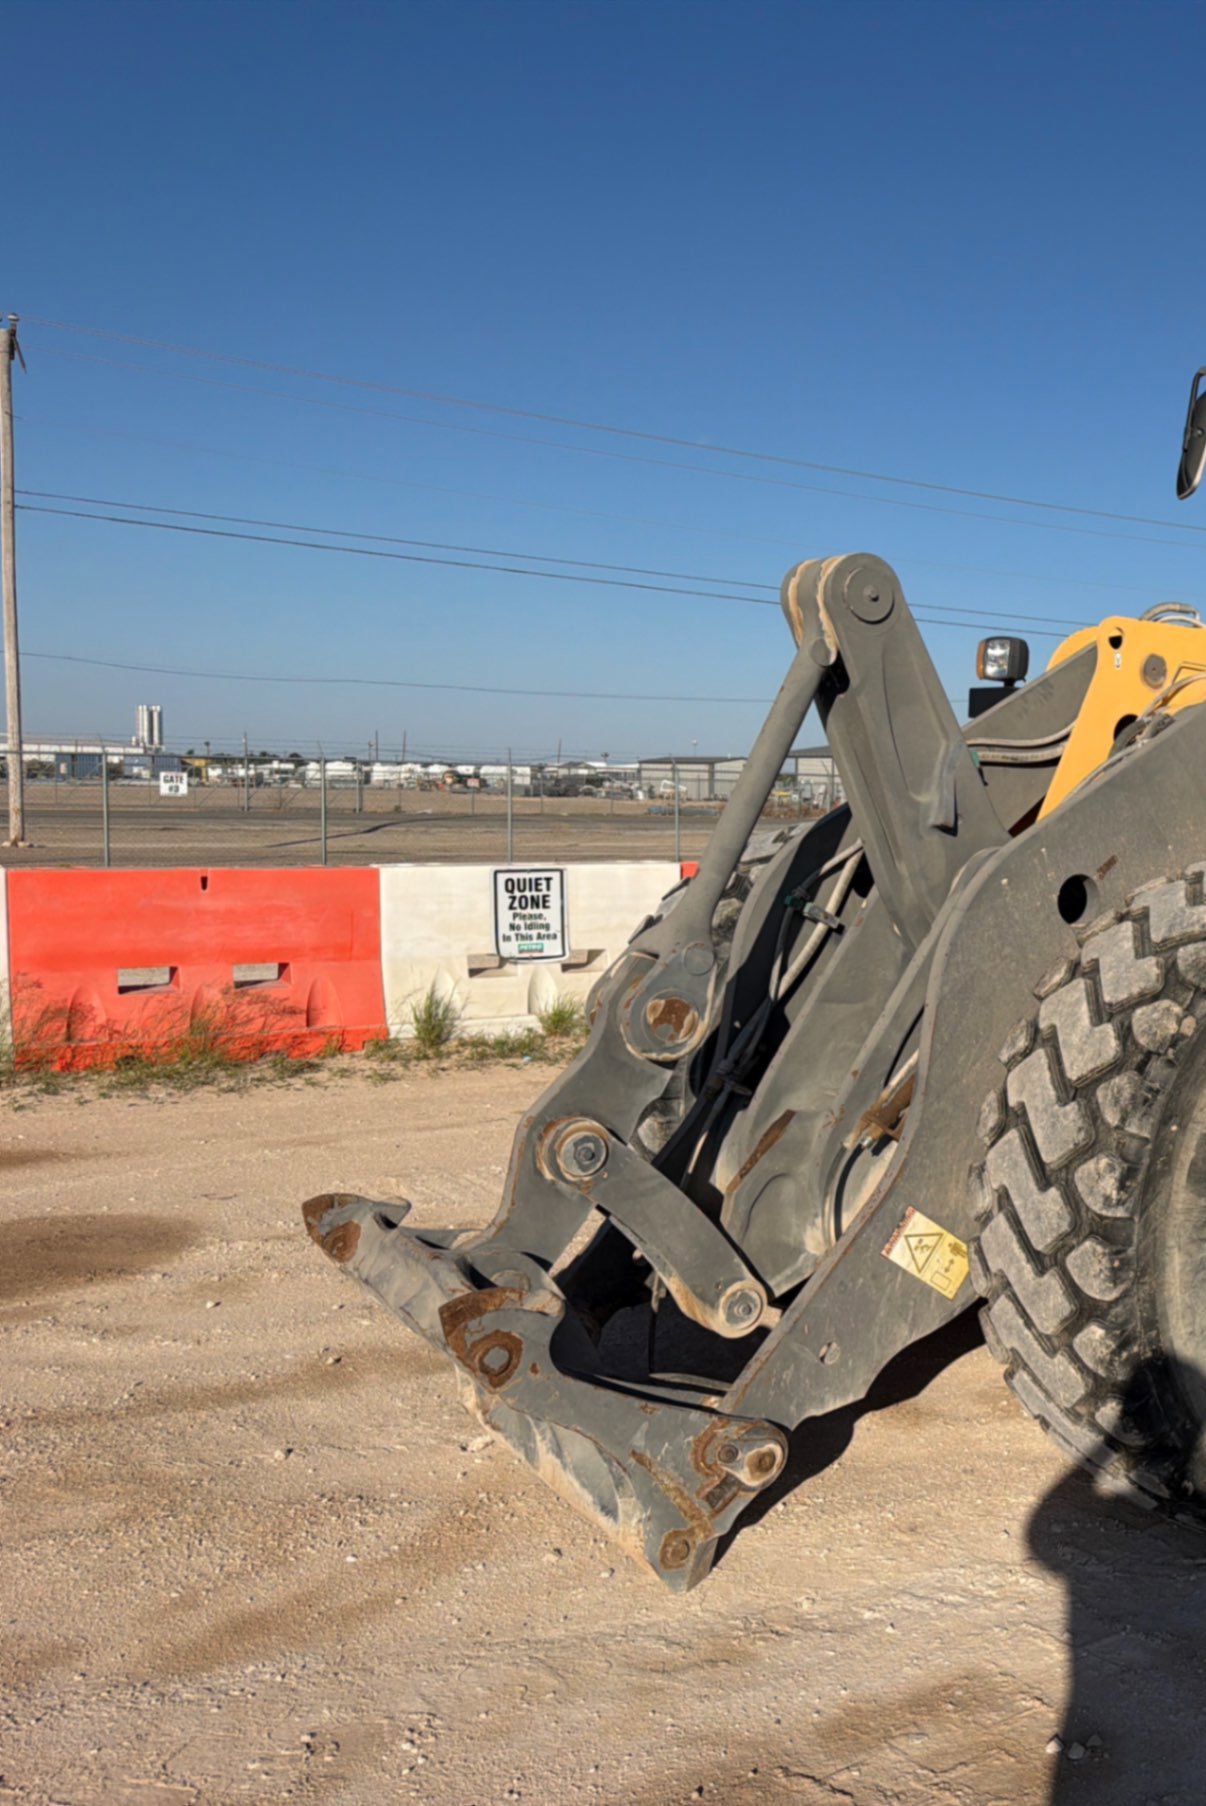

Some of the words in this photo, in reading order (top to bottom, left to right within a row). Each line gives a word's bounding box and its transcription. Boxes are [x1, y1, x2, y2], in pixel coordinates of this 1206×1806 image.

[163, 775, 184, 784] GATE
[504, 877, 553, 894] QUIET
[508, 894, 551, 910] ZONE
[512, 912, 547, 921] Please,
[509, 923, 521, 931] No
[524, 921, 551, 932] Idling
[502, 934, 511, 942] In
[515, 932, 533, 942] This
[536, 931, 557, 941] Area
